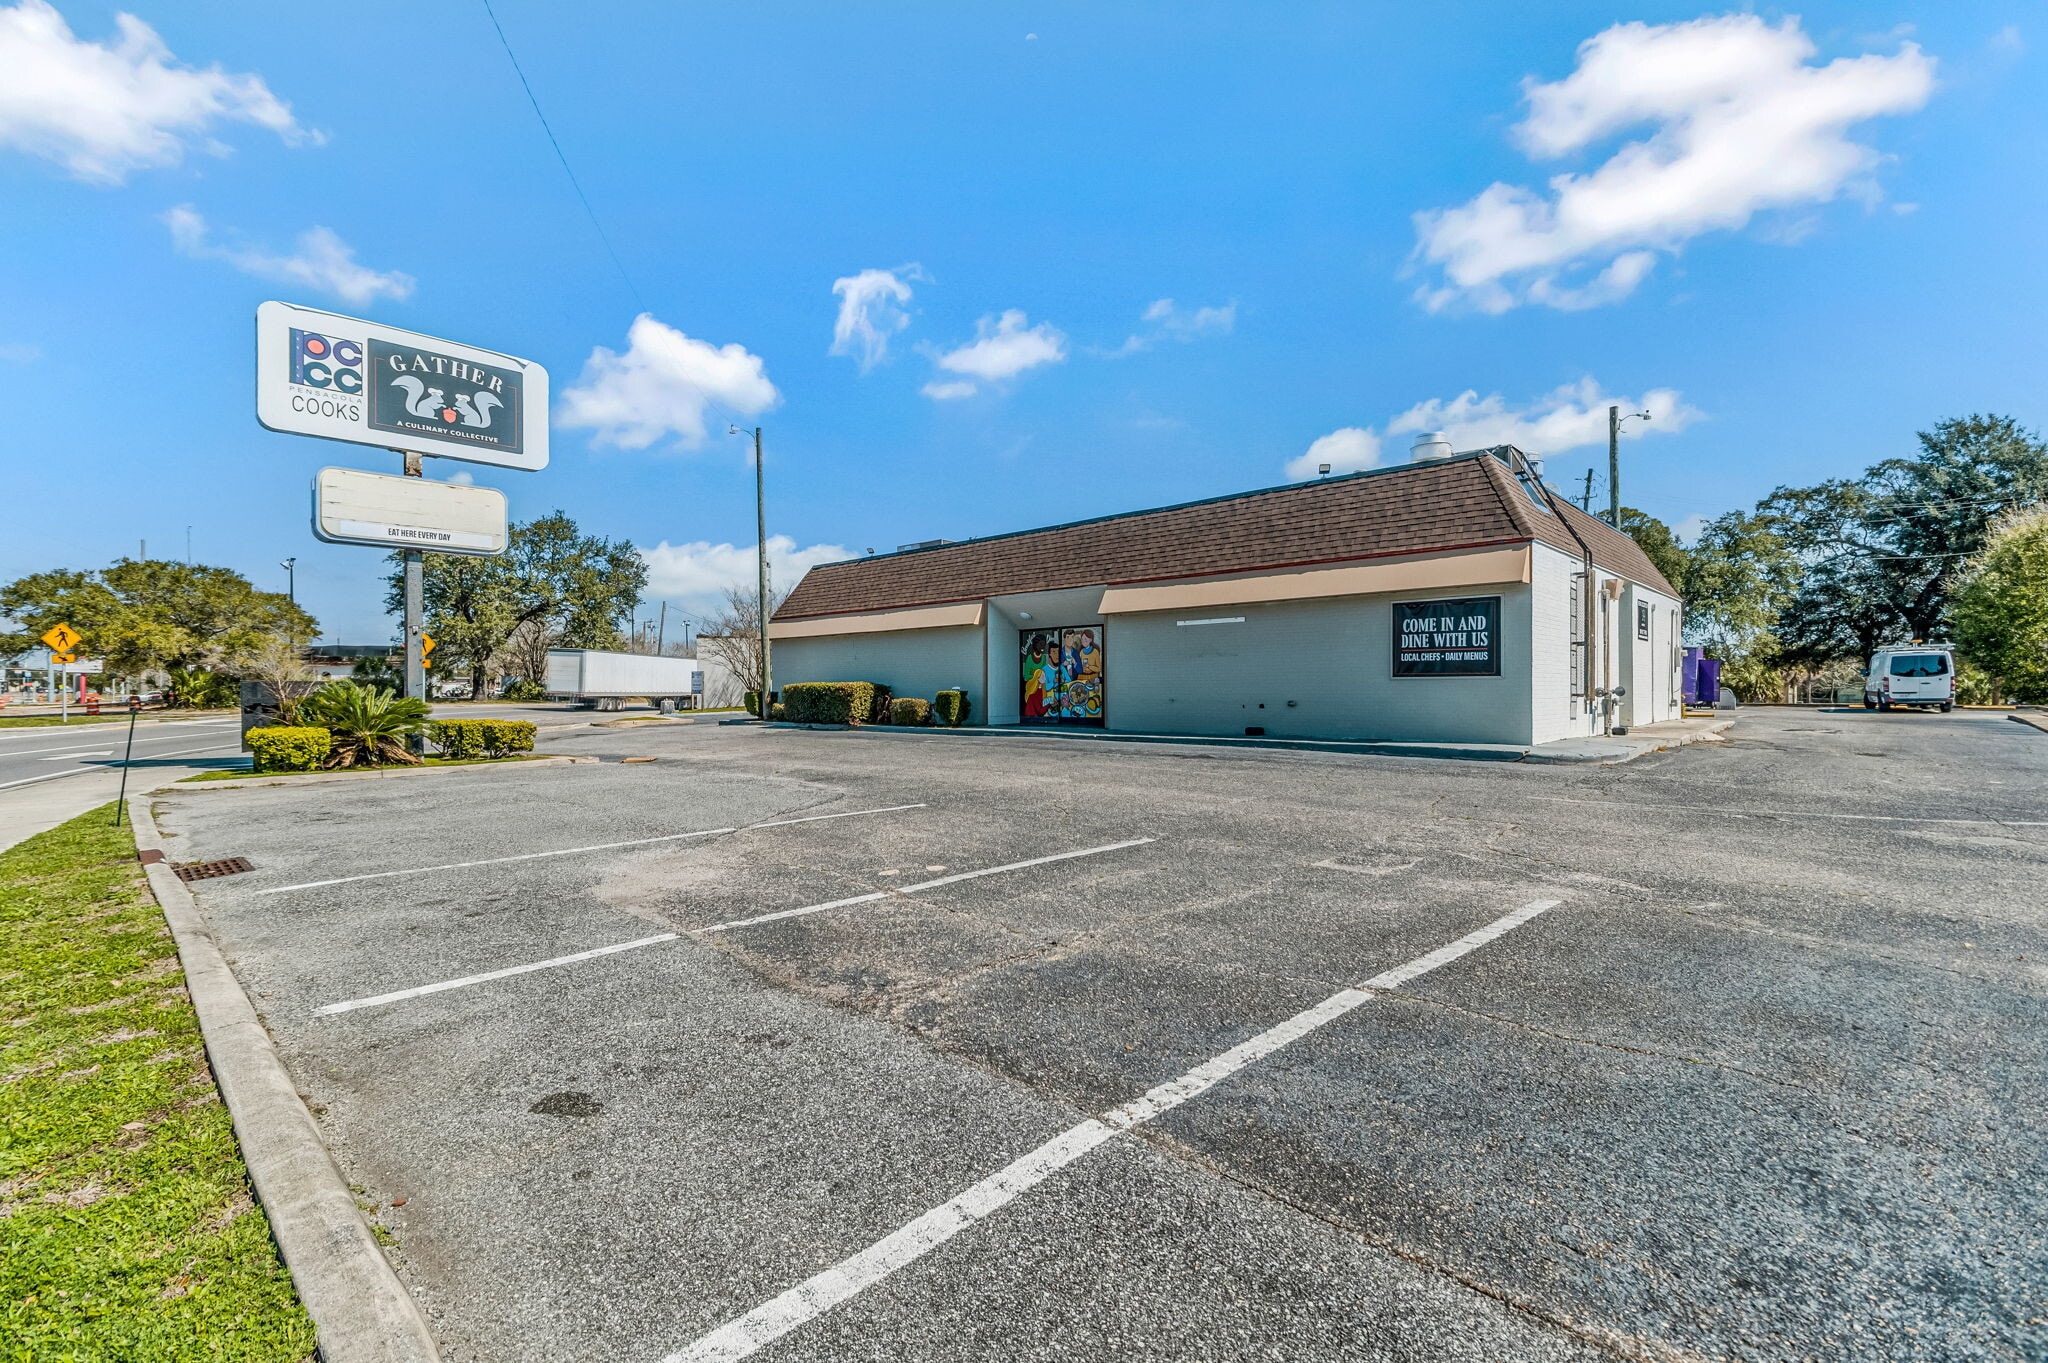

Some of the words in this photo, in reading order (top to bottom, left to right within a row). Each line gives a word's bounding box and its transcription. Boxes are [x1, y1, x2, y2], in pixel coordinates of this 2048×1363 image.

[389, 354, 504, 393] GATHER
[289, 386, 362, 403] PENSACOLA
[292, 395, 360, 422] COOKS
[405, 422, 448, 434] CULINARY
[450, 430, 499, 443] COLLECTIVE
[388, 528, 400, 536] EAT
[401, 529, 417, 538] HERE
[418, 531, 438, 540] EVERY
[438, 533, 451, 541] DAY
[1402, 617, 1437, 632] COME
[1441, 617, 1454, 631] IN
[1458, 615, 1486, 631] AND
[1401, 633, 1429, 648] DINE
[1433, 632, 1467, 647] WITH
[1472, 632, 1488, 646] US
[1401, 653, 1420, 661] LOCAL
[1421, 652, 1441, 661] CHEFS
[1445, 652, 1463, 661] DAILY
[1463, 652, 1488, 661] MENUS
